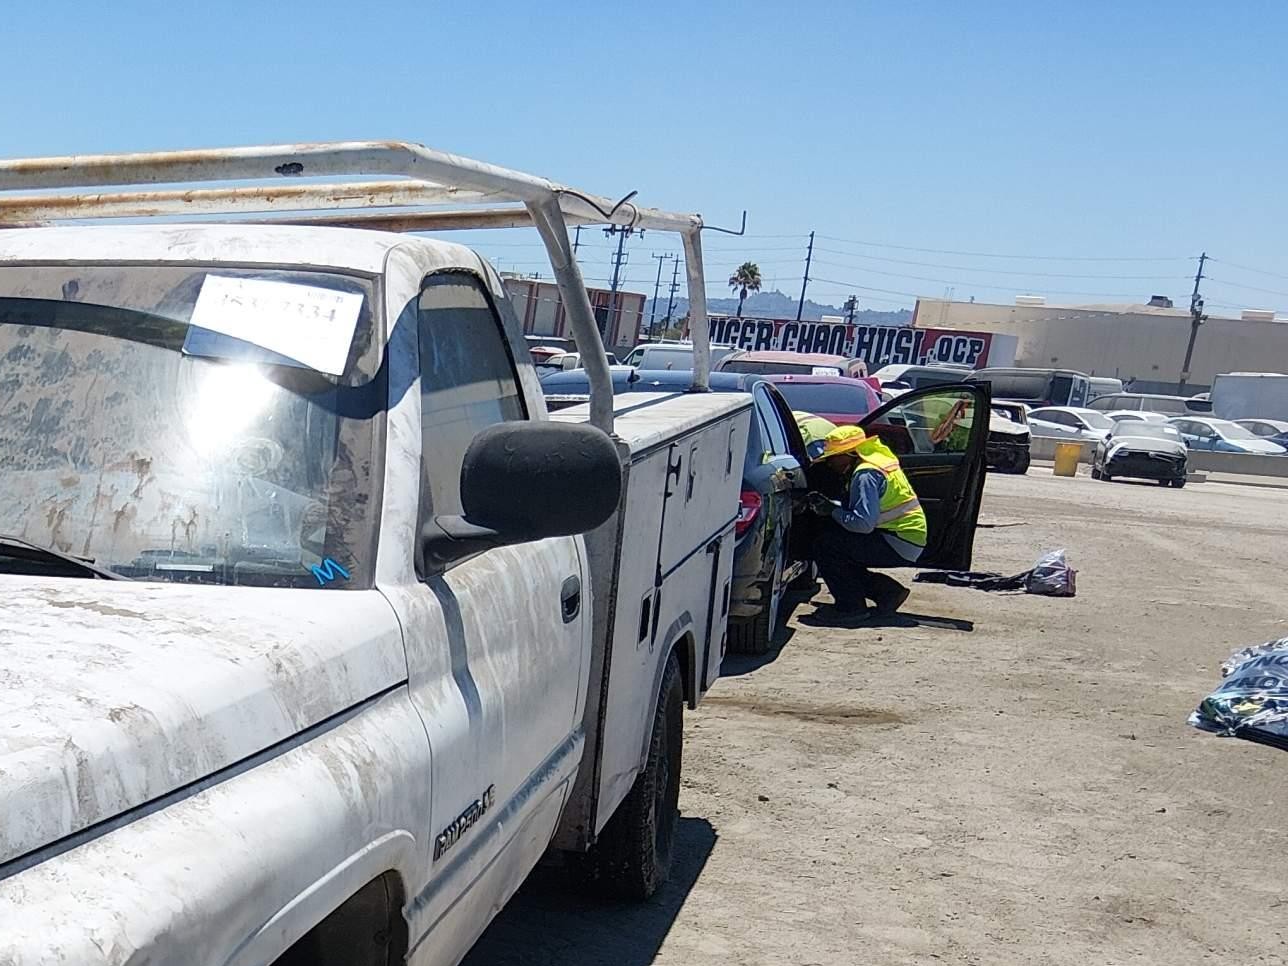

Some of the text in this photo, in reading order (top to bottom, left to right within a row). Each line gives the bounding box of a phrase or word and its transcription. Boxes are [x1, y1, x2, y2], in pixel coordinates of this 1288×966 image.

[707, 317, 774, 352] UGER
[780, 321, 847, 356] CHAO
[311, 558, 350, 586] M
